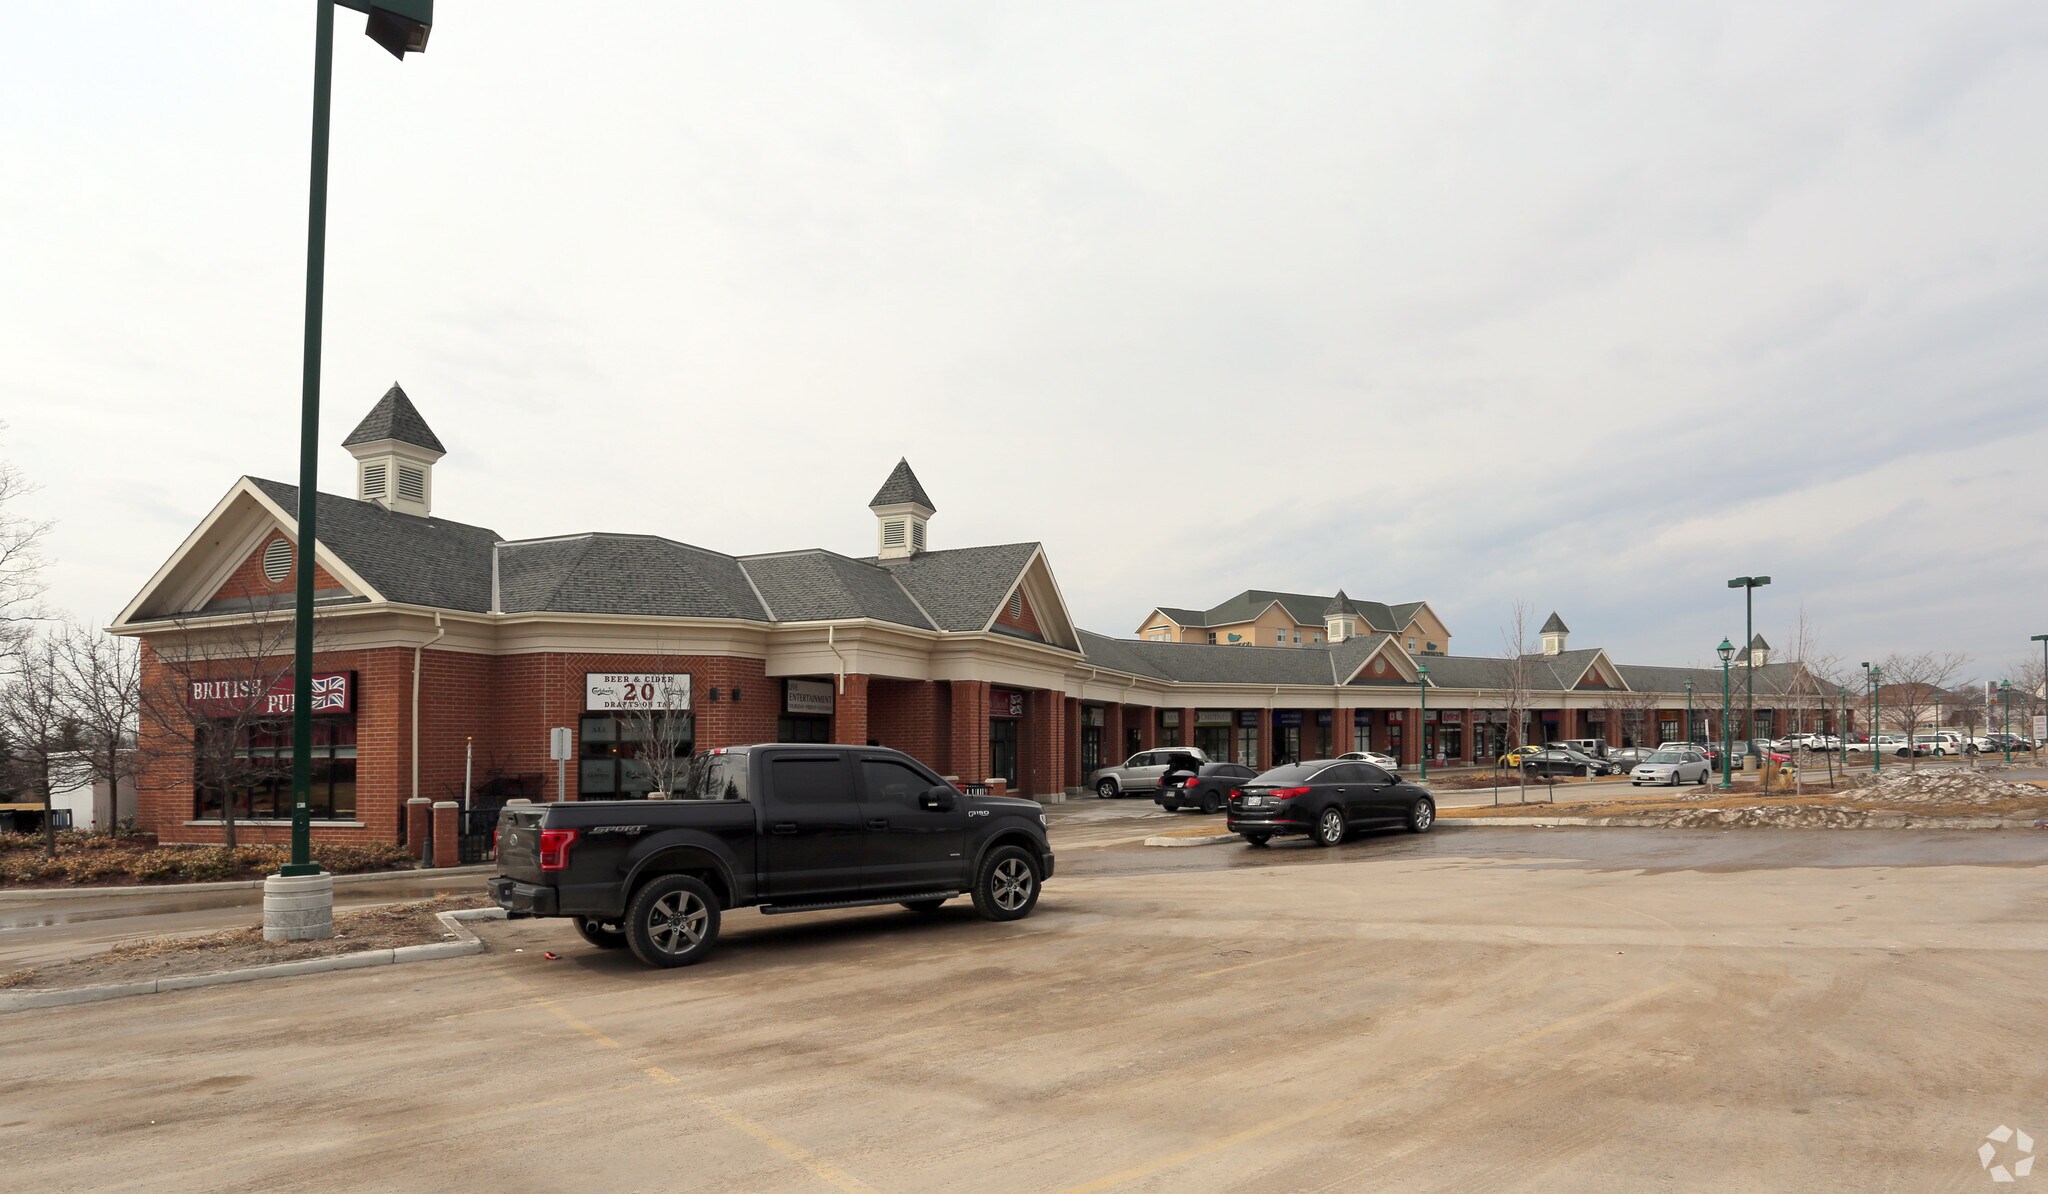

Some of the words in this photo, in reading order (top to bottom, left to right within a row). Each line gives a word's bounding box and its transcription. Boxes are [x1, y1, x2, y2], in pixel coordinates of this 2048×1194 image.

[192, 679, 262, 700] BRITISH
[623, 683, 655, 701] 20
[789, 693, 832, 704] ENTERTAINMENT
[587, 824, 648, 835] SPORT
